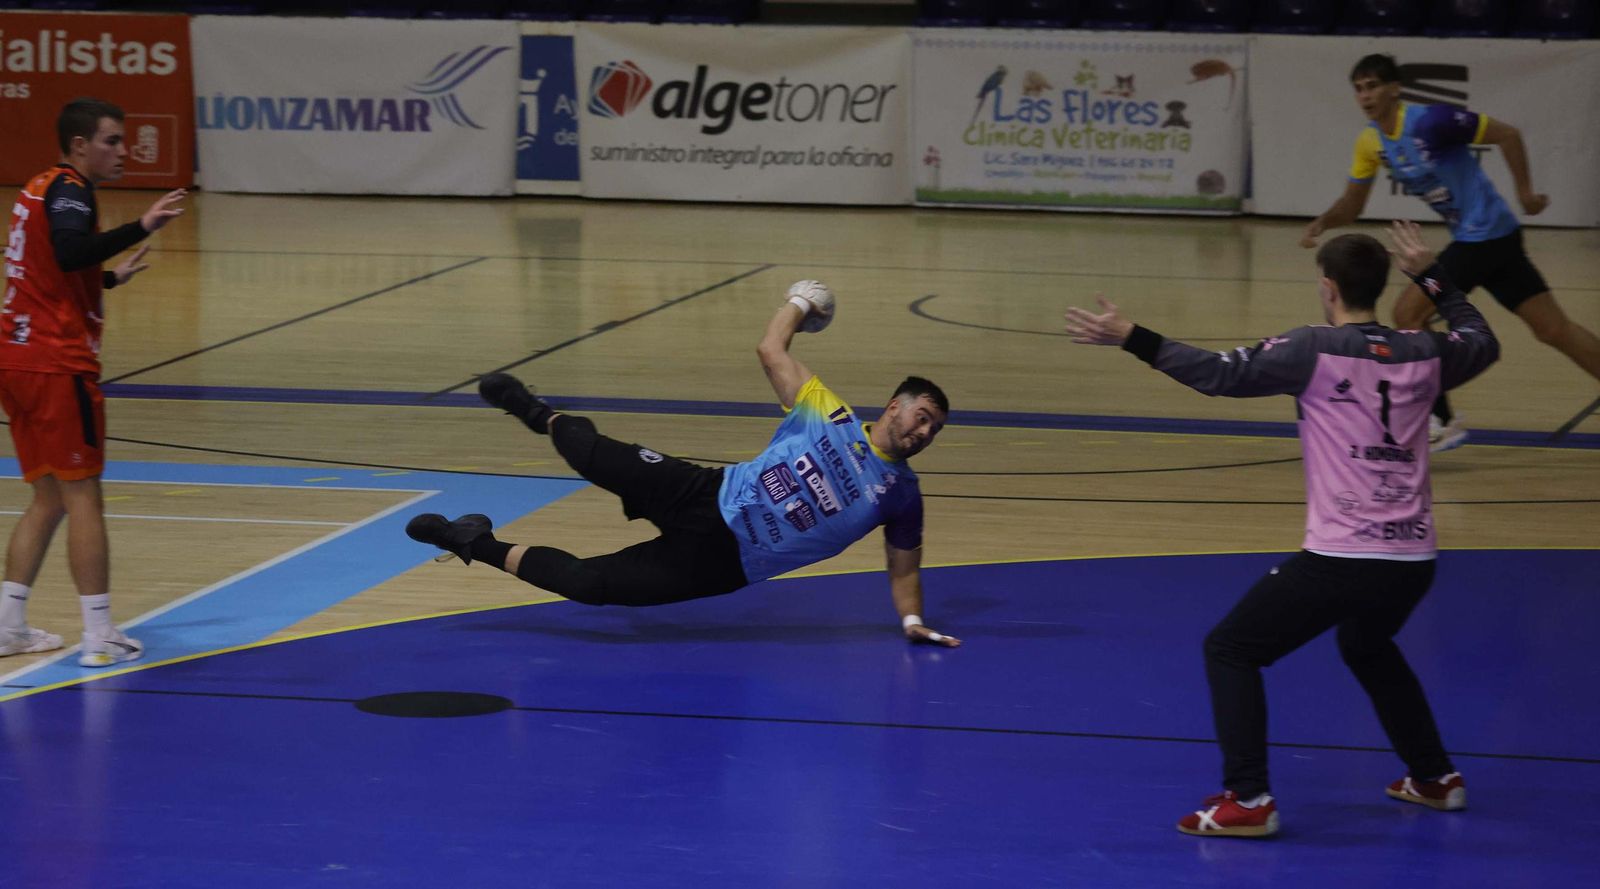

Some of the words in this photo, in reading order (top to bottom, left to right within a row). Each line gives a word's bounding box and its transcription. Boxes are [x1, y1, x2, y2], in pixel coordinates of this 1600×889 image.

[0, 29, 178, 75] alistas
[0, 82, 31, 98] as
[652, 65, 897, 135] algetoner
[993, 88, 1052, 124] Las
[1052, 121, 1193, 153] Veterinaria
[590, 142, 687, 163] suministro
[687, 143, 761, 170] integral
[760, 151, 805, 170] para
[806, 146, 825, 167] la
[827, 145, 894, 168] oficina
[828, 405, 854, 426] 17
[818, 434, 861, 502] IBERSUR
